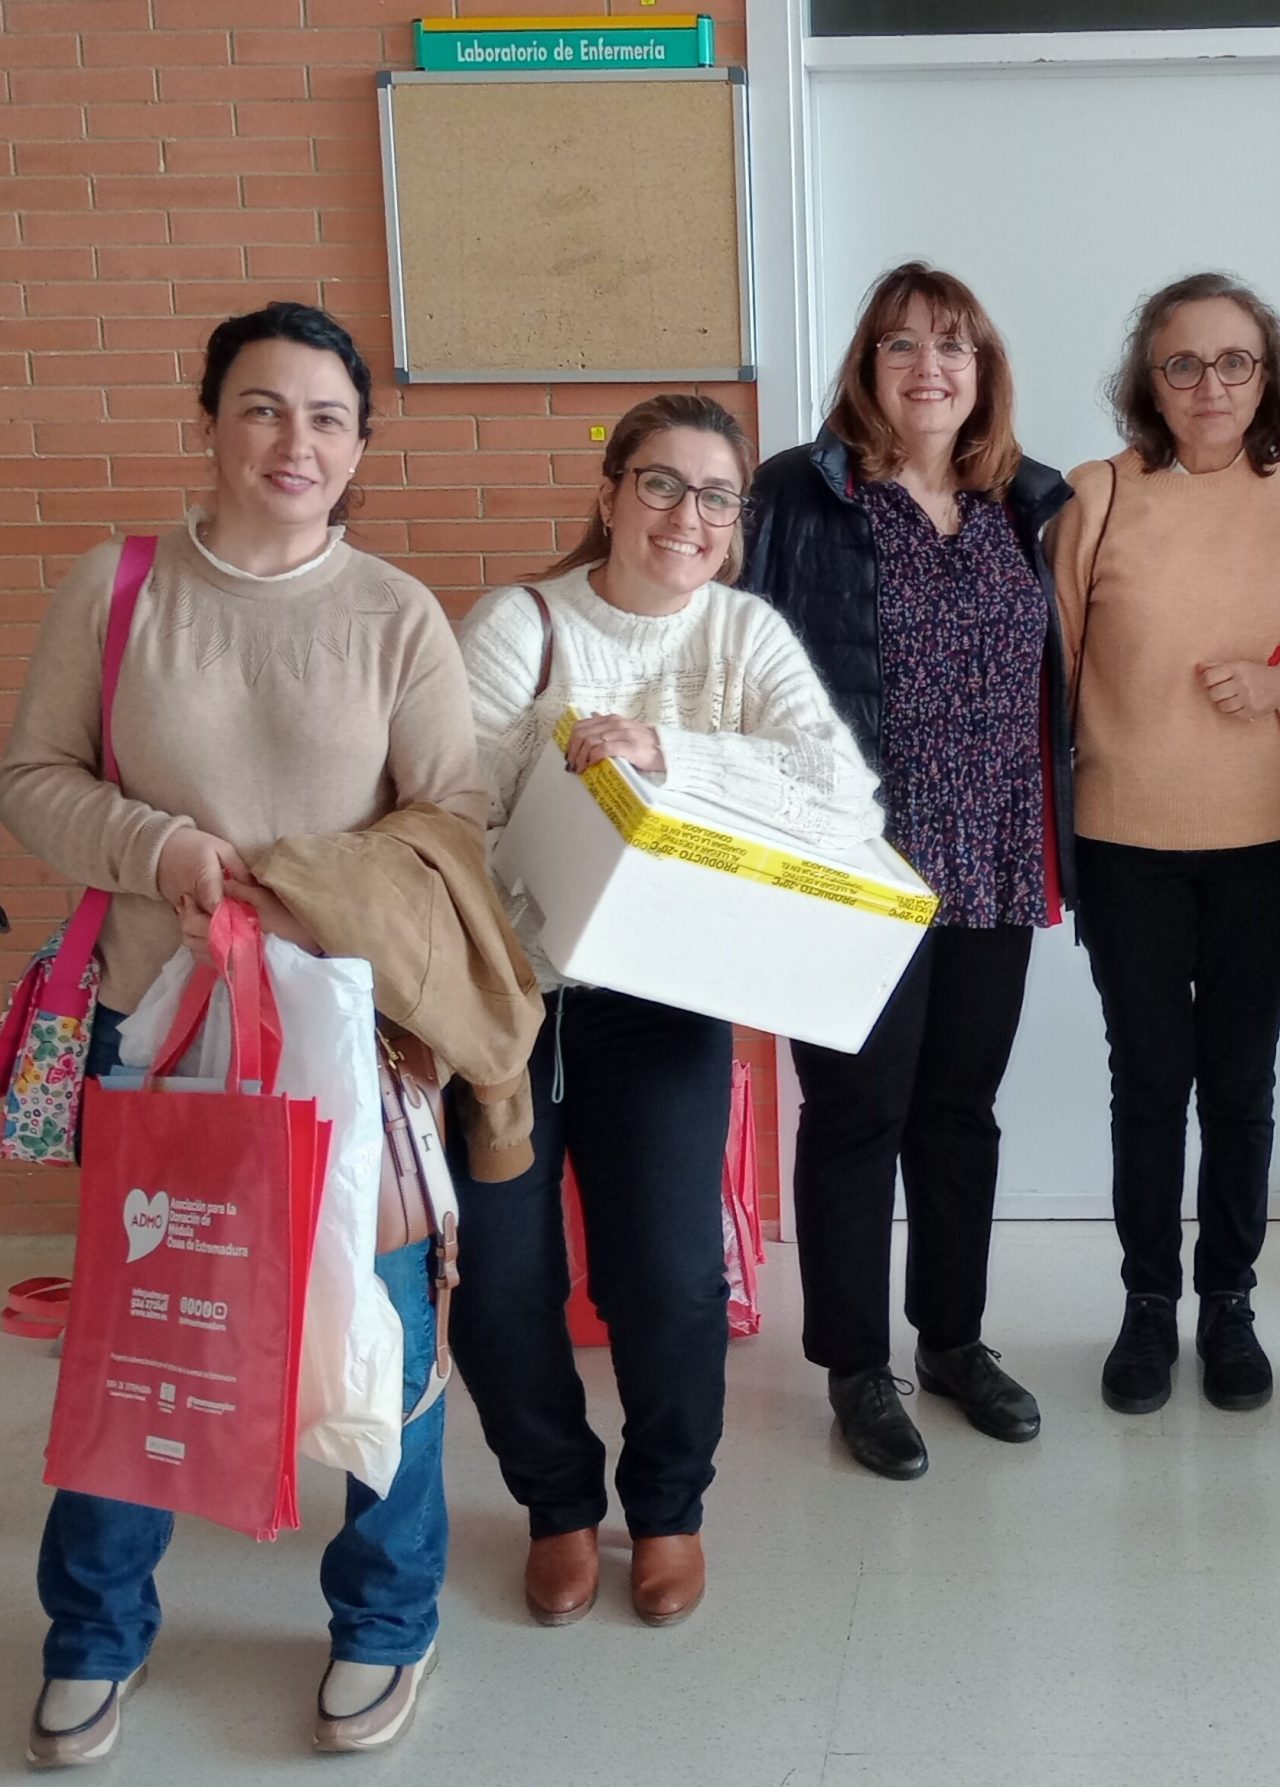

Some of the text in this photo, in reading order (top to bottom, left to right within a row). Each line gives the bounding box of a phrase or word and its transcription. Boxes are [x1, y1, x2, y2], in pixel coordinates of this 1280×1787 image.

[457, 38, 665, 62] Laboratorio de Enfermería
[678, 848, 739, 874] PRODUCTO
[799, 883, 857, 907] PRODUCTO
[131, 1212, 162, 1229] ADMO
